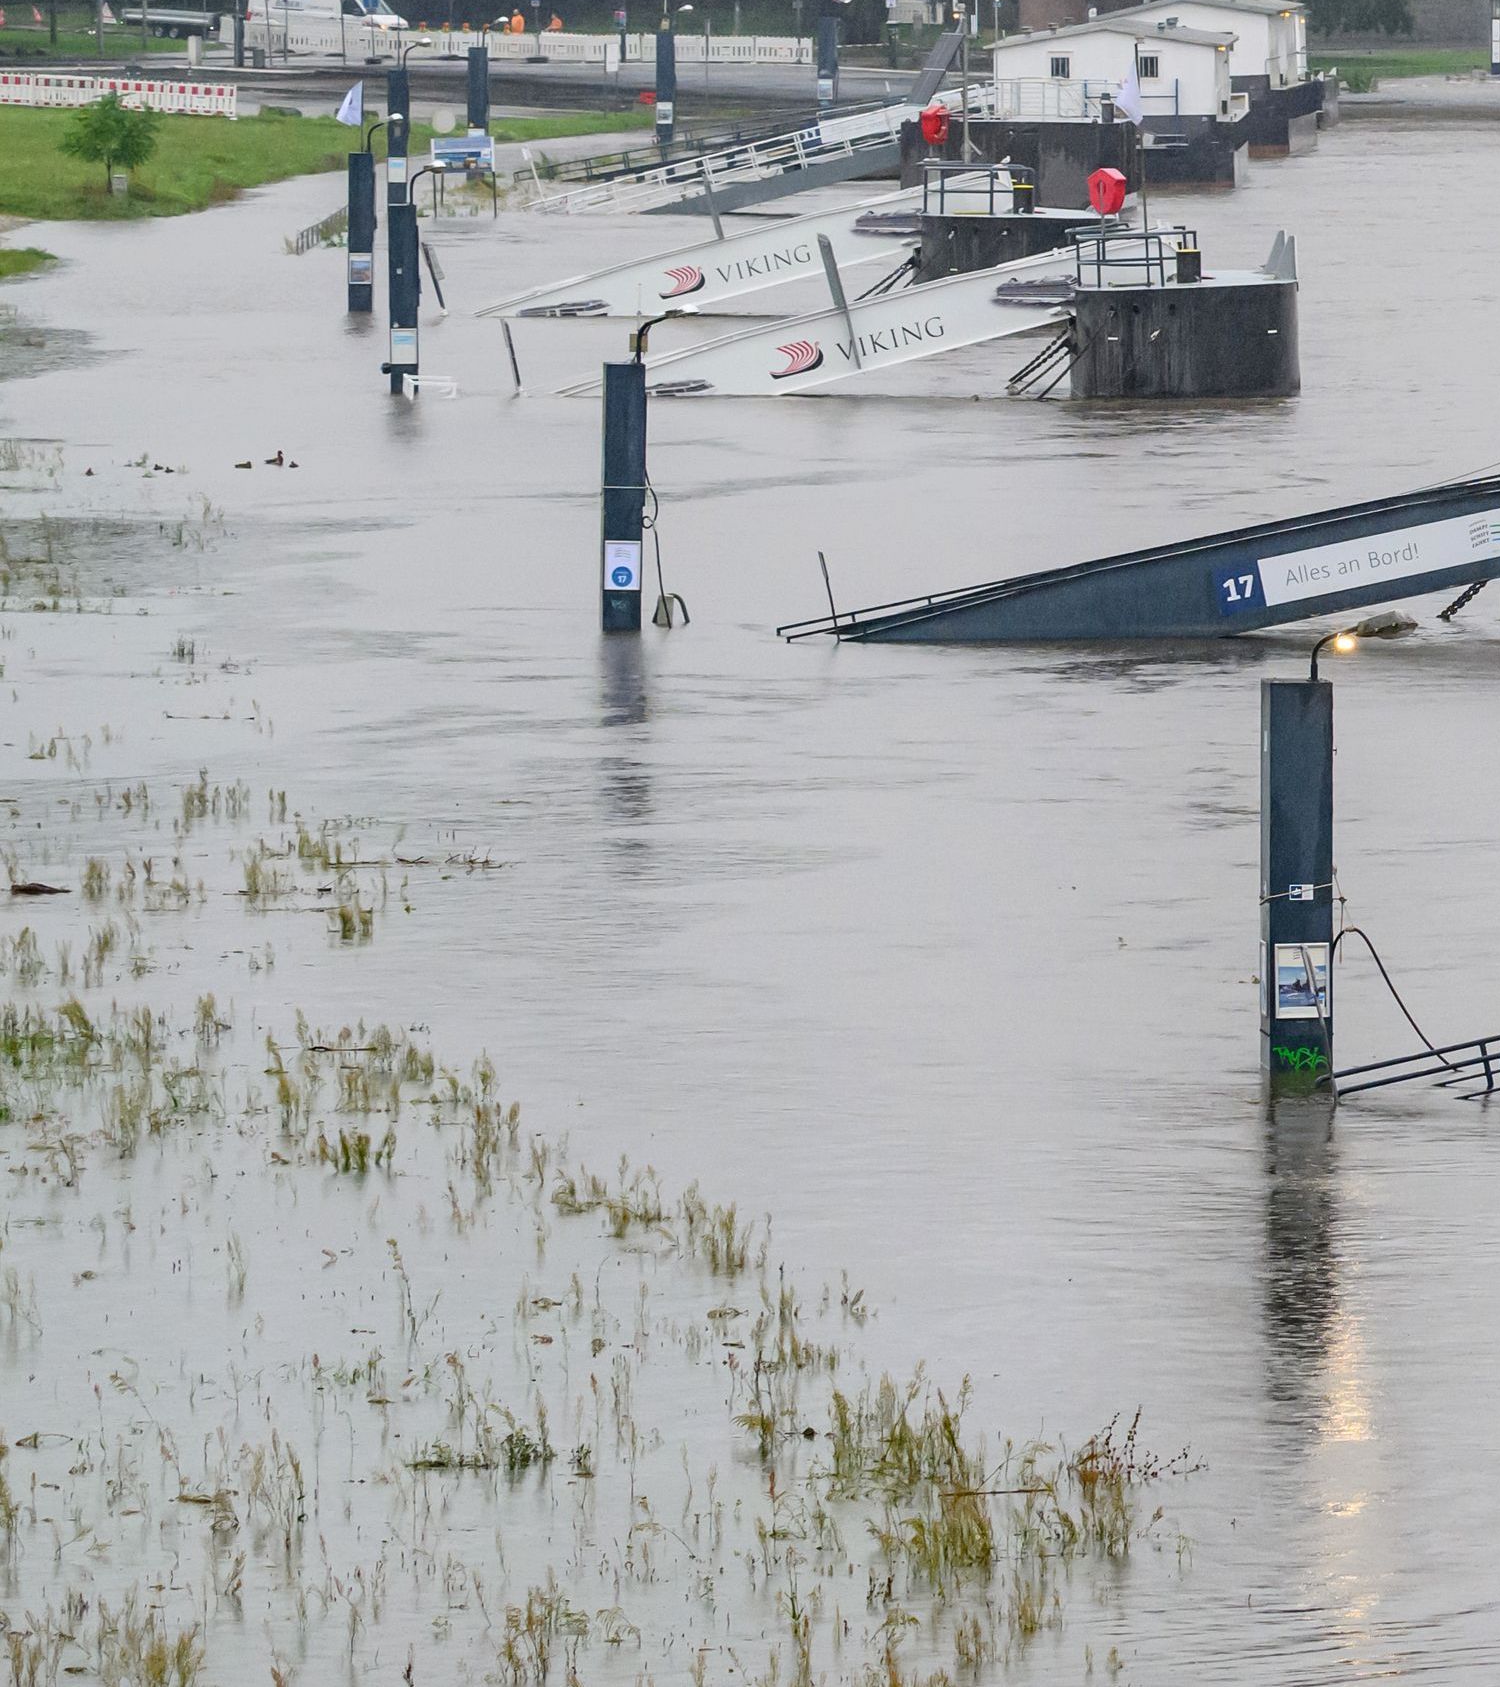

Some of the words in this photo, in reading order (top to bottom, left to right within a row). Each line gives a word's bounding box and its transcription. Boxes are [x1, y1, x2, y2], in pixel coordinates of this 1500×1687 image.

[716, 244, 811, 283] VIKING
[836, 316, 945, 362] VIKING
[1286, 565, 1331, 587] Alles
[1338, 558, 1360, 575] an
[1368, 542, 1420, 569] Bord!
[1222, 574, 1254, 602] 17
